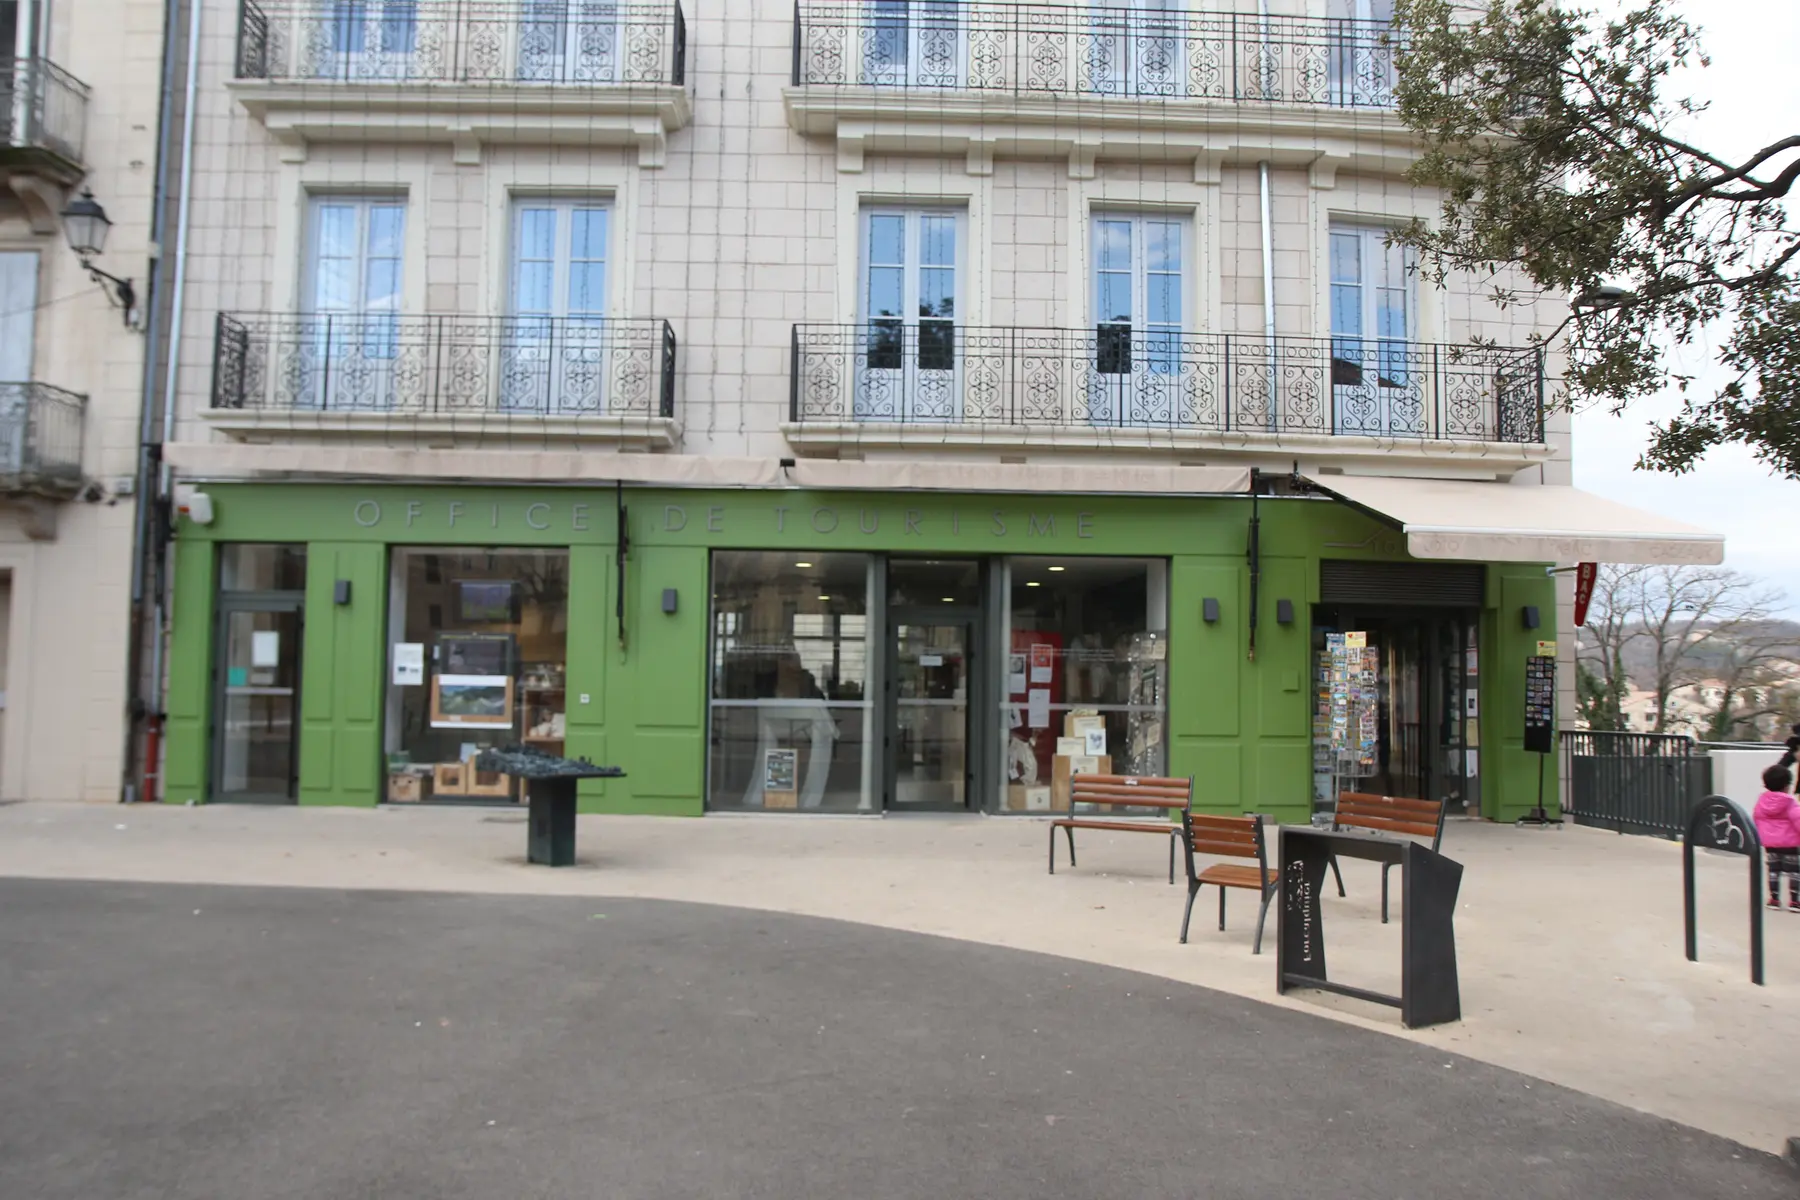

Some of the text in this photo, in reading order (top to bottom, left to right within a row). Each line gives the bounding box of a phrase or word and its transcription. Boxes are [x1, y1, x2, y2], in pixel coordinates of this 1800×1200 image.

[353, 500, 1095, 539] OFFICE DE TOURISME
